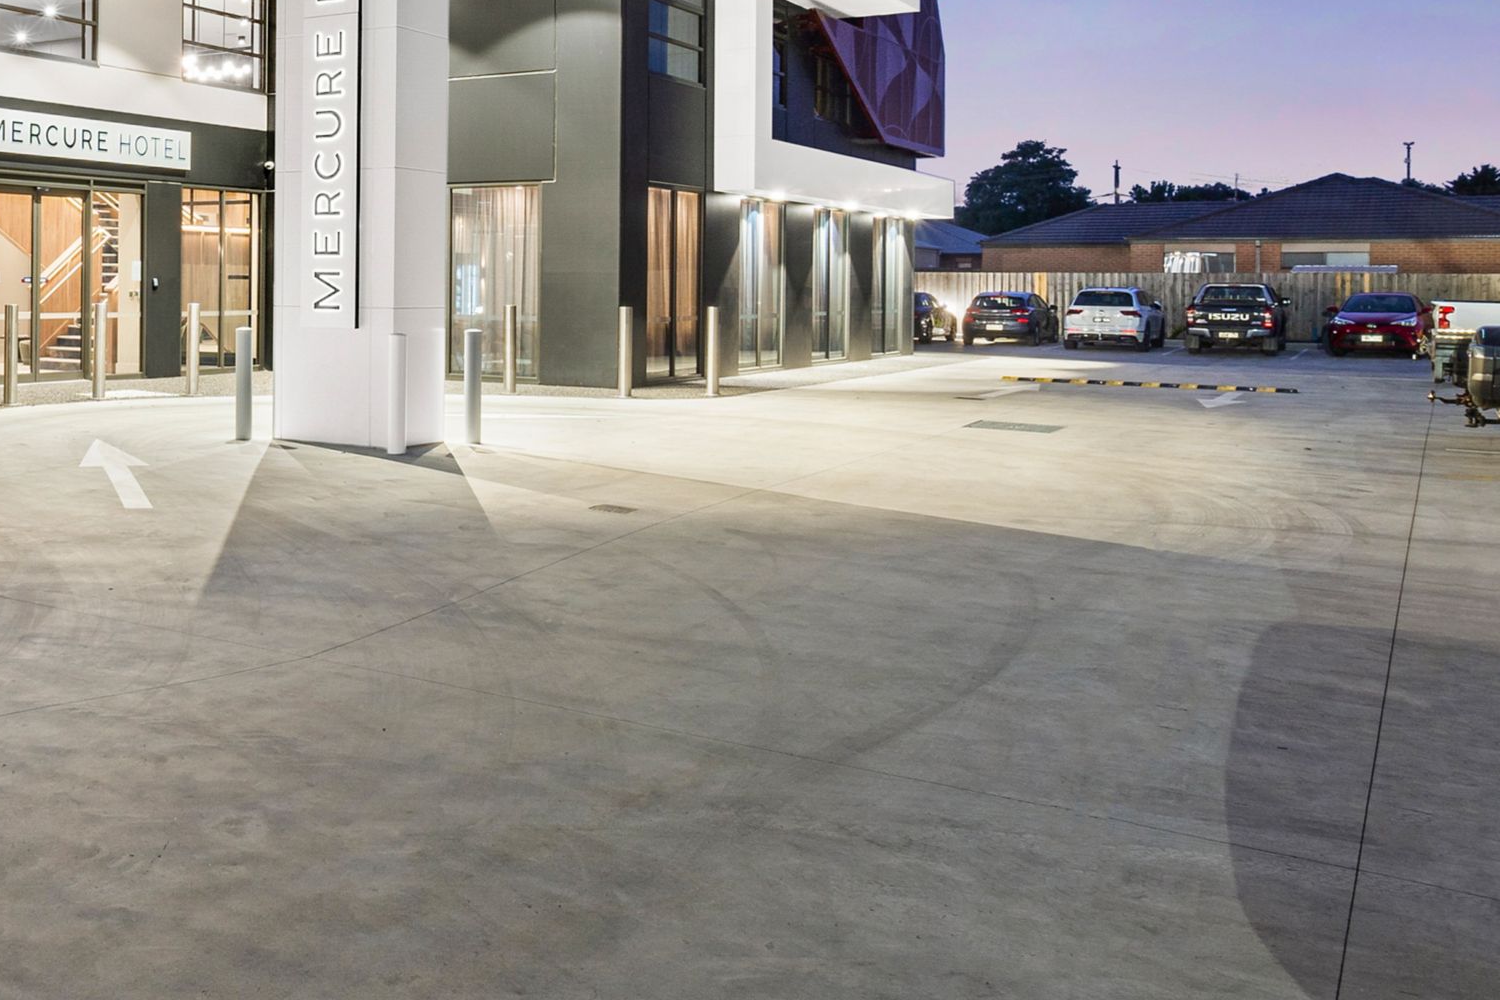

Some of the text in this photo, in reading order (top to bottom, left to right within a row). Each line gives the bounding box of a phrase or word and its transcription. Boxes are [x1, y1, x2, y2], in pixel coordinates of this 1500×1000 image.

[119, 133, 187, 161] HOTEL
[314, 29, 346, 312] MERCURE
[1208, 312, 1250, 321] ISUZU
